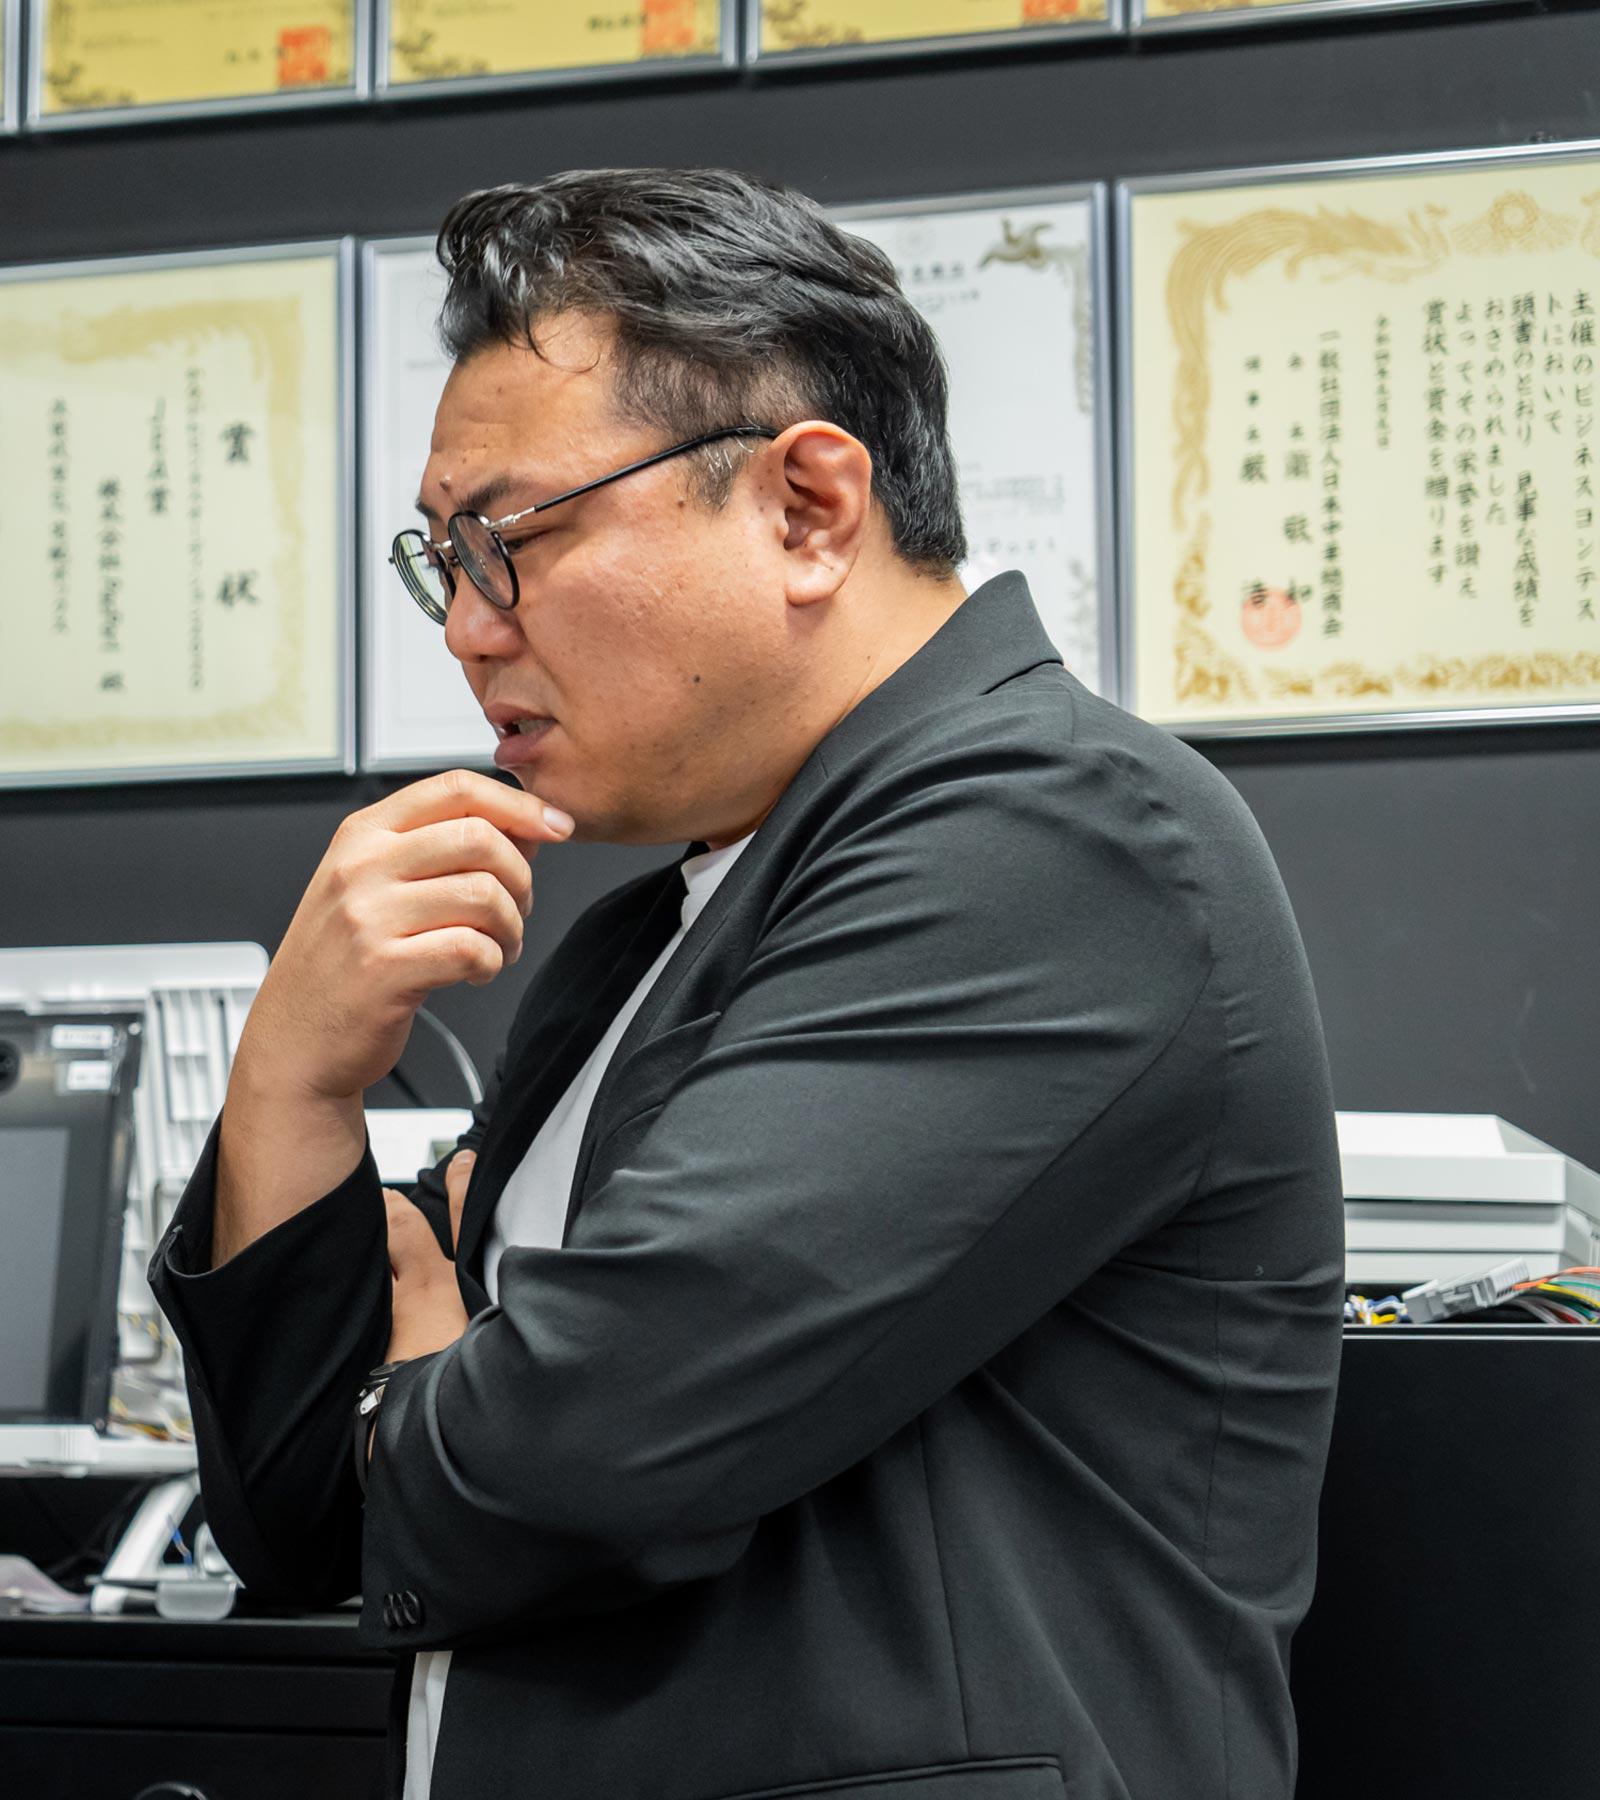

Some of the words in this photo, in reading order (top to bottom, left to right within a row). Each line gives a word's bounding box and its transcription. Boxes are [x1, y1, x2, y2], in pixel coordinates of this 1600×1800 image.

[1421, 297, 1448, 586] 賞状と賞金を贈ります
[1483, 298, 1506, 525] おさめられました
[1511, 291, 1536, 446] 頭書のとおり
[1542, 293, 1564, 434] トにおいて
[1513, 470, 1540, 628] 見事な成績を
